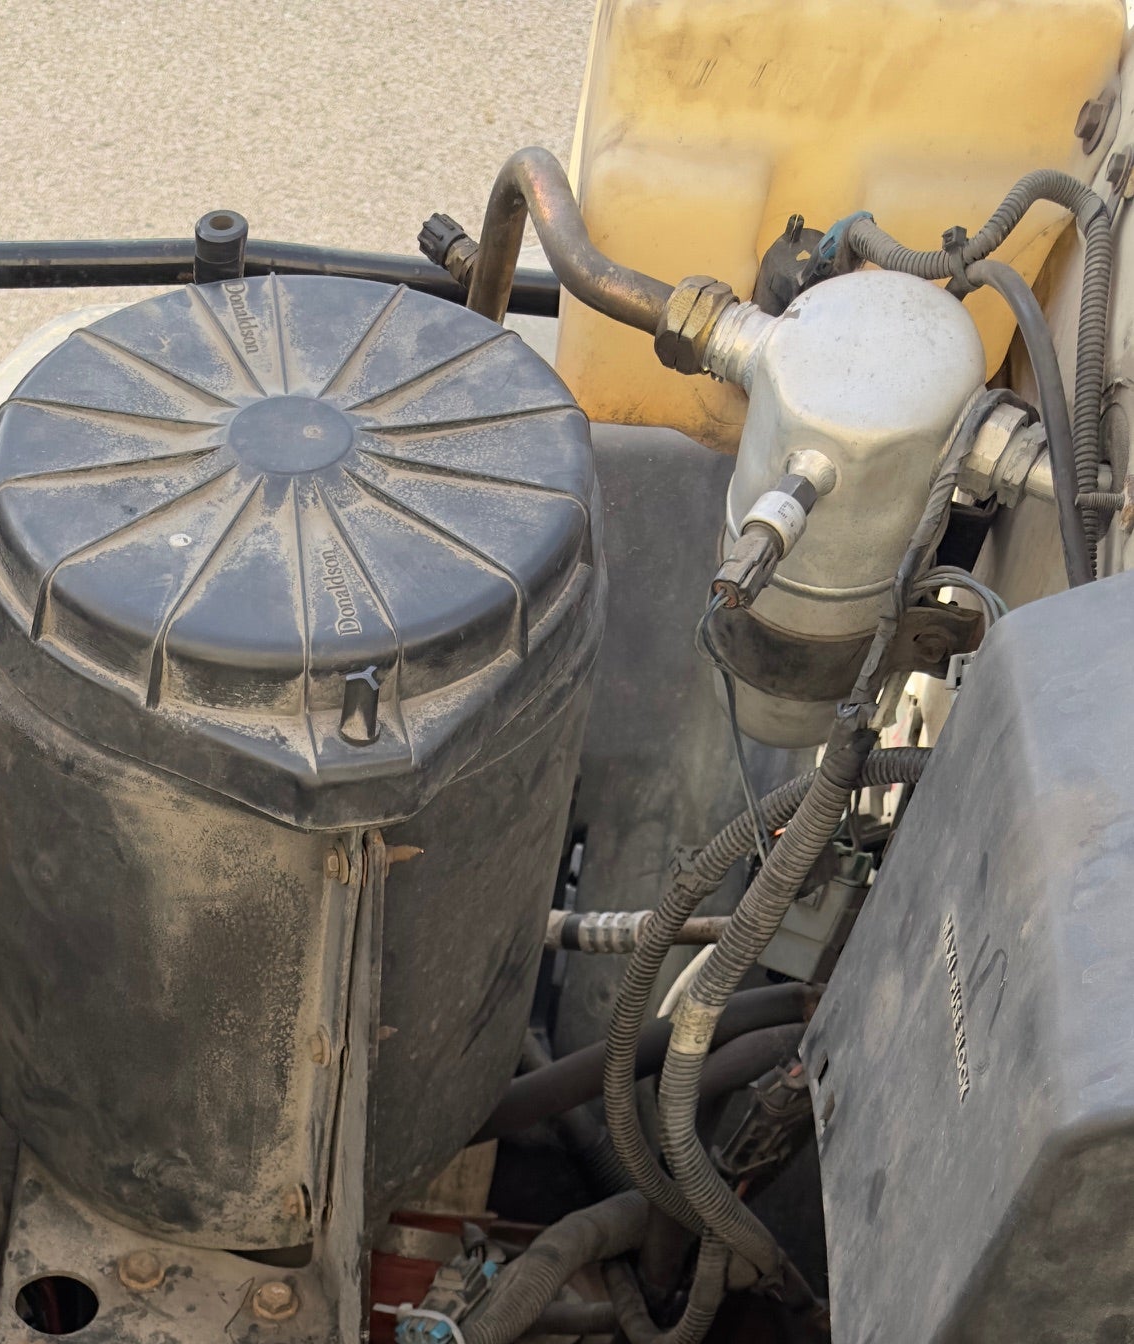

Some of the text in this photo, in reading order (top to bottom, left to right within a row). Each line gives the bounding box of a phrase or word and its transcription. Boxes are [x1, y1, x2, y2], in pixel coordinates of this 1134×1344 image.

[223, 282, 259, 354] Donaldson
[321, 549, 361, 636] Donaldson
[955, 1025, 970, 1103] BLOCK
